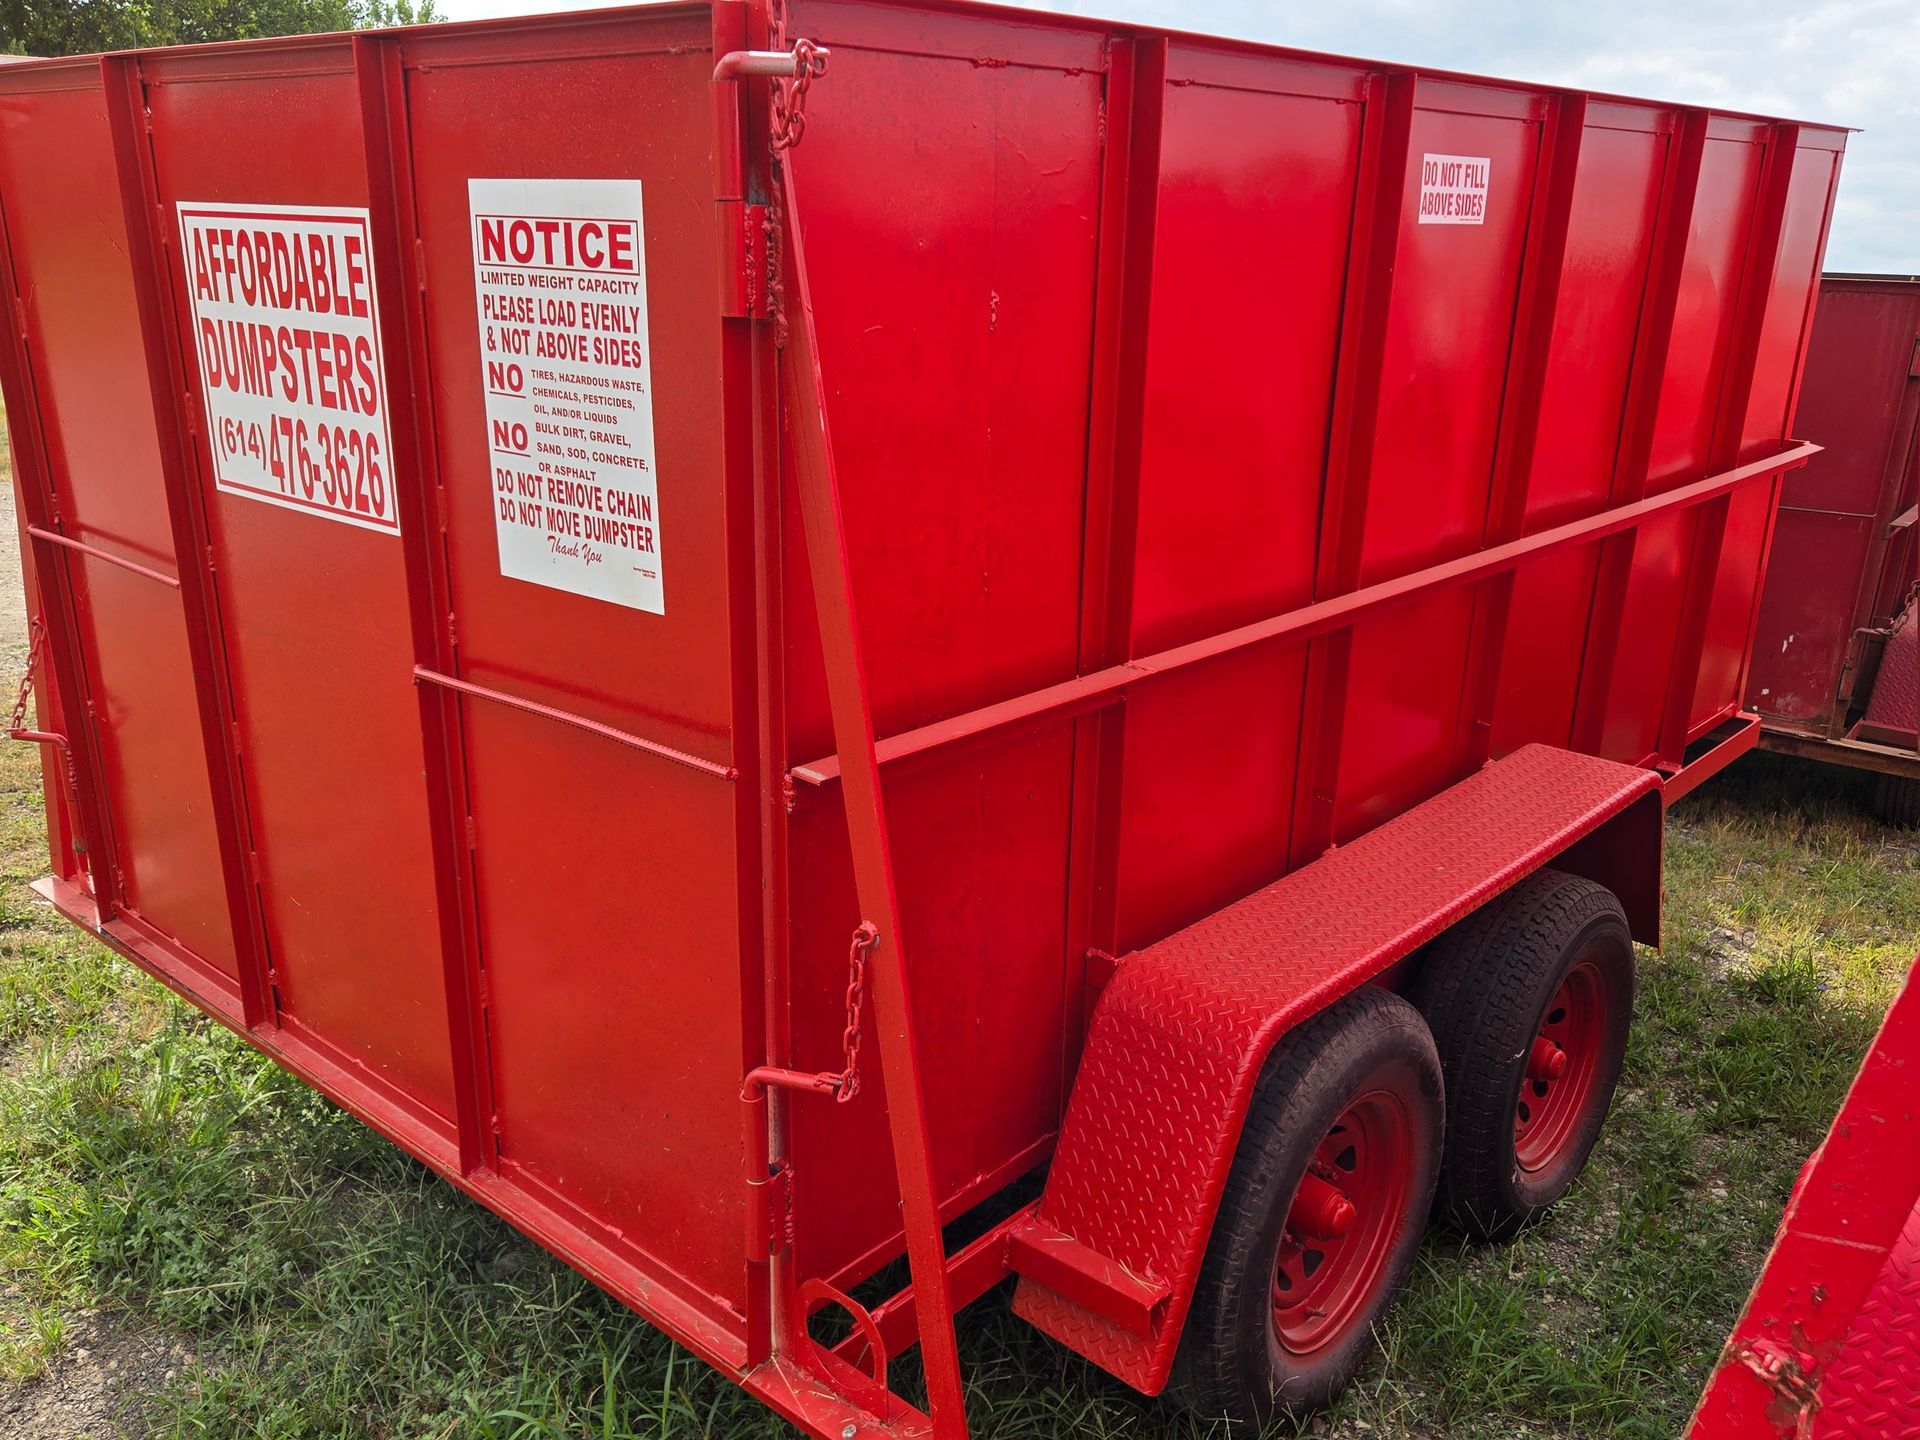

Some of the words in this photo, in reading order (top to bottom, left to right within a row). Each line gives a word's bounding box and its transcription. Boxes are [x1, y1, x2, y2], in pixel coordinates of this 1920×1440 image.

[1424, 161, 1438, 187] DO
[1440, 162, 1462, 188] NOT
[1464, 164, 1485, 188] FILL
[1421, 192, 1453, 216] ABOVE
[1455, 193, 1483, 217] SIDES
[480, 219, 634, 270] NOTICE
[193, 227, 369, 319] AFFORDABLE
[481, 271, 525, 287] LIMITED
[528, 274, 574, 290] WEIGHT
[578, 278, 639, 295] CAPACITY
[483, 294, 535, 324] PLEASE
[538, 298, 577, 328] LOAD
[581, 302, 640, 334] EVENLY
[486, 325, 497, 352] &
[500, 327, 531, 355] NOT
[536, 331, 589, 362] ABOVE
[593, 336, 642, 369] SIDES
[200, 316, 378, 417] DUMPSTERS
[488, 361, 524, 392] NO
[531, 369, 557, 383] TIRES,
[559, 373, 610, 388] HAZARDOUS
[611, 379, 645, 394] WASTE,
[532, 387, 581, 404] CHEMICALS,
[583, 394, 636, 411] PESTICIDES,
[534, 404, 550, 416] OIL,
[551, 407, 582, 420] AND/OR
[584, 411, 618, 425] LIQUIDS
[493, 419, 529, 451] NO
[535, 422, 561, 436] BULK
[563, 426, 587, 442] DIRT,
[589, 430, 632, 449] GRAVEL,
[536, 442, 565, 458] SAND,
[567, 447, 590, 463] SOD,
[592, 452, 649, 473] CONCRETE,
[538, 462, 551, 473] OR
[554, 465, 597, 482] ASPHALT
[496, 467, 514, 494] DO
[517, 471, 543, 500] NOT
[547, 477, 604, 513] REMOVE
[607, 488, 652, 522] CHAIN
[500, 497, 516, 523] DO
[519, 502, 543, 529] NOT
[546, 507, 581, 538] MOVE
[583, 514, 655, 553] DUMPSTER
[547, 535, 580, 558] Thank
[581, 543, 603, 566] You
